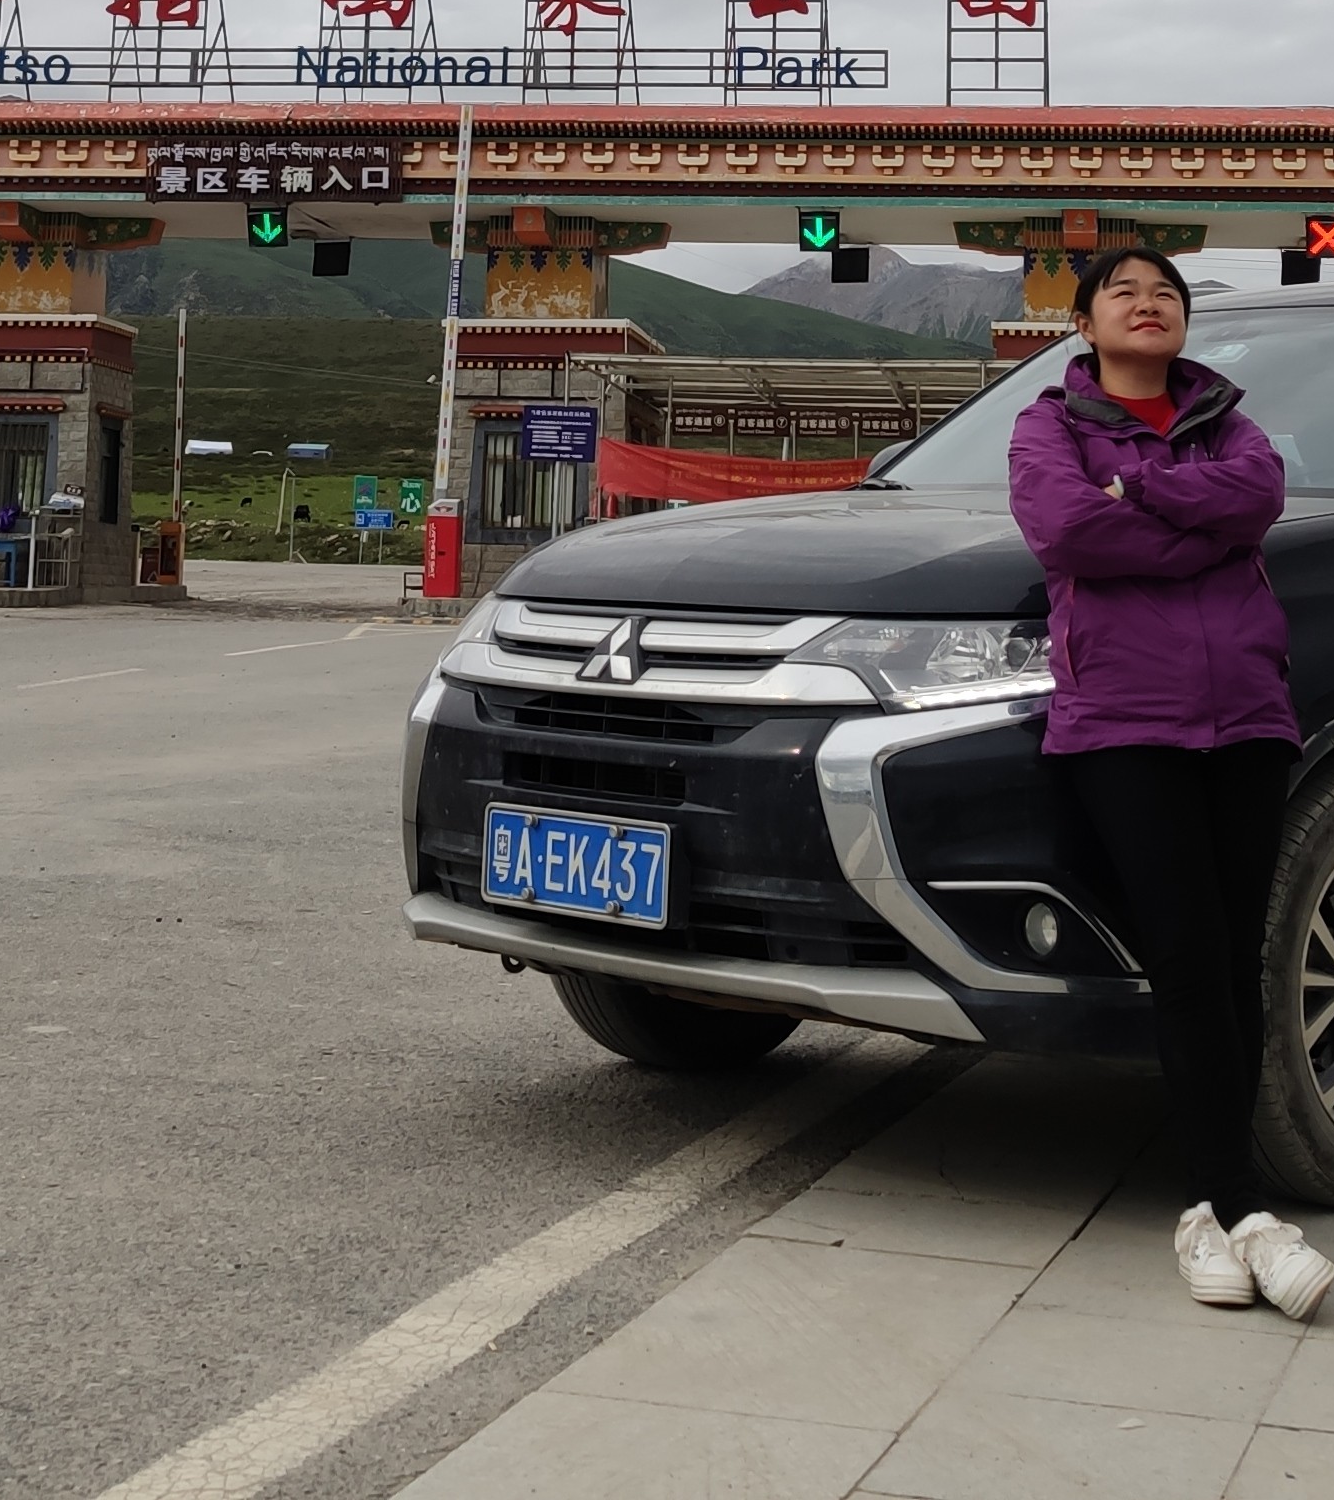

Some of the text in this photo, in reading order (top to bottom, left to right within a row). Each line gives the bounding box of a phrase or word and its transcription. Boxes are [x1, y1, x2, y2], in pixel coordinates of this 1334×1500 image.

[295, 45, 509, 87] National
[736, 46, 860, 88] Park
[155, 165, 390, 193] 景区车辆入口
